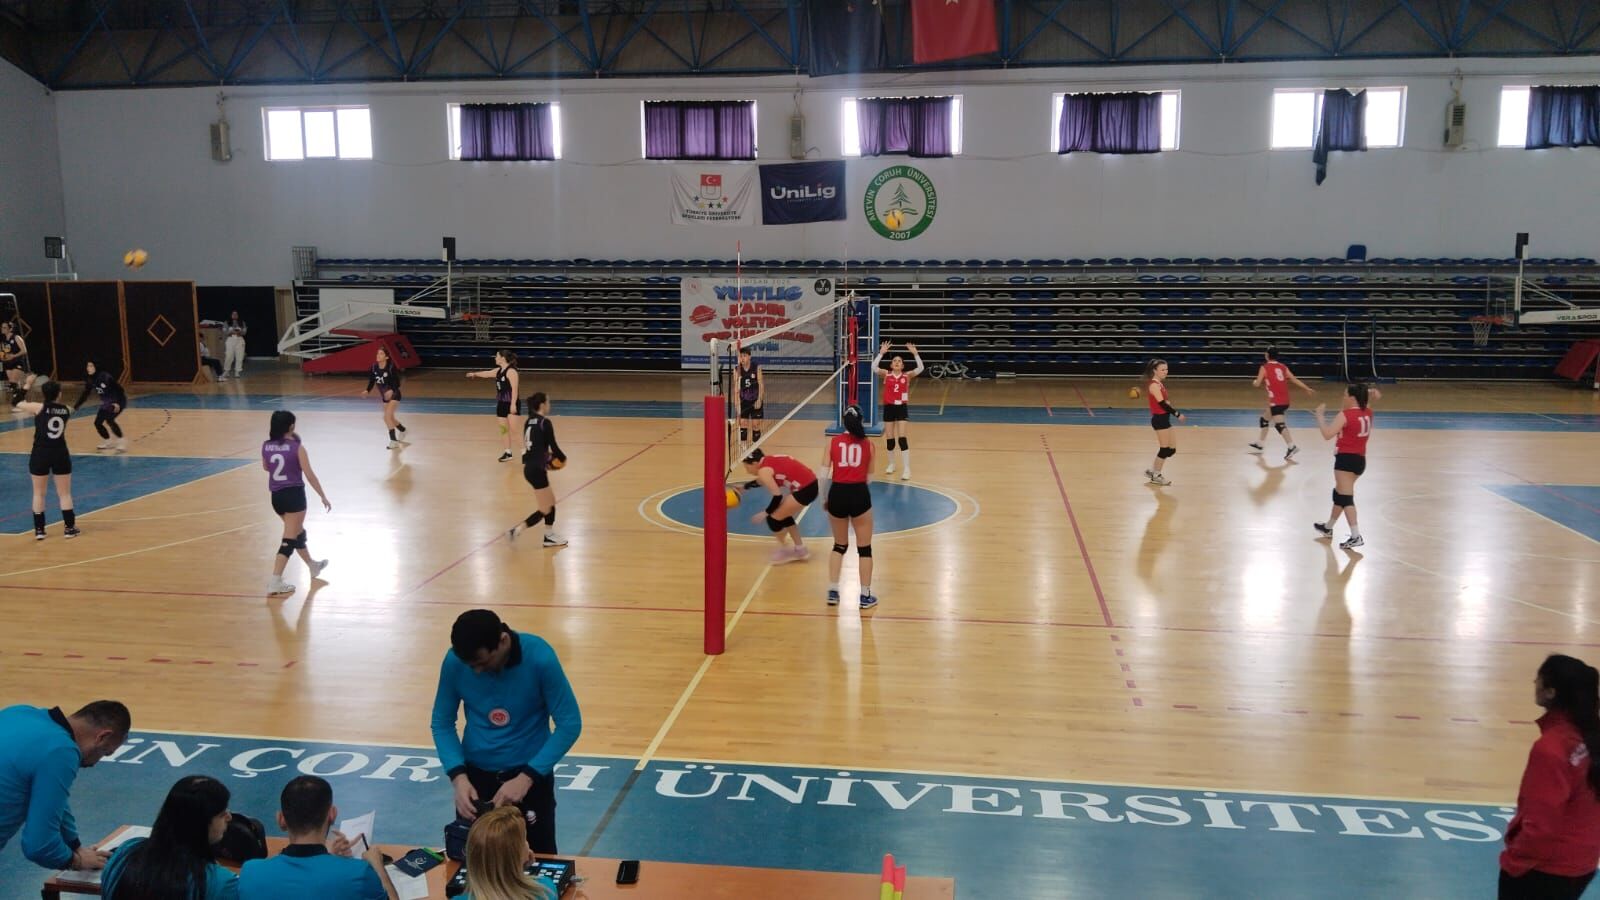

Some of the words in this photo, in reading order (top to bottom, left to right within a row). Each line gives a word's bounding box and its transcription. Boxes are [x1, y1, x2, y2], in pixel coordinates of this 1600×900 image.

[889, 231, 911, 239] 2007
[375, 376, 385, 384] 21
[1275, 368, 1284, 381] 8
[744, 379, 751, 387] 5
[893, 384, 900, 393] 2
[47, 416, 65, 439] 9
[838, 442, 863, 468] 10
[270, 453, 288, 481] 2
[229, 747, 610, 791] ÇORH
